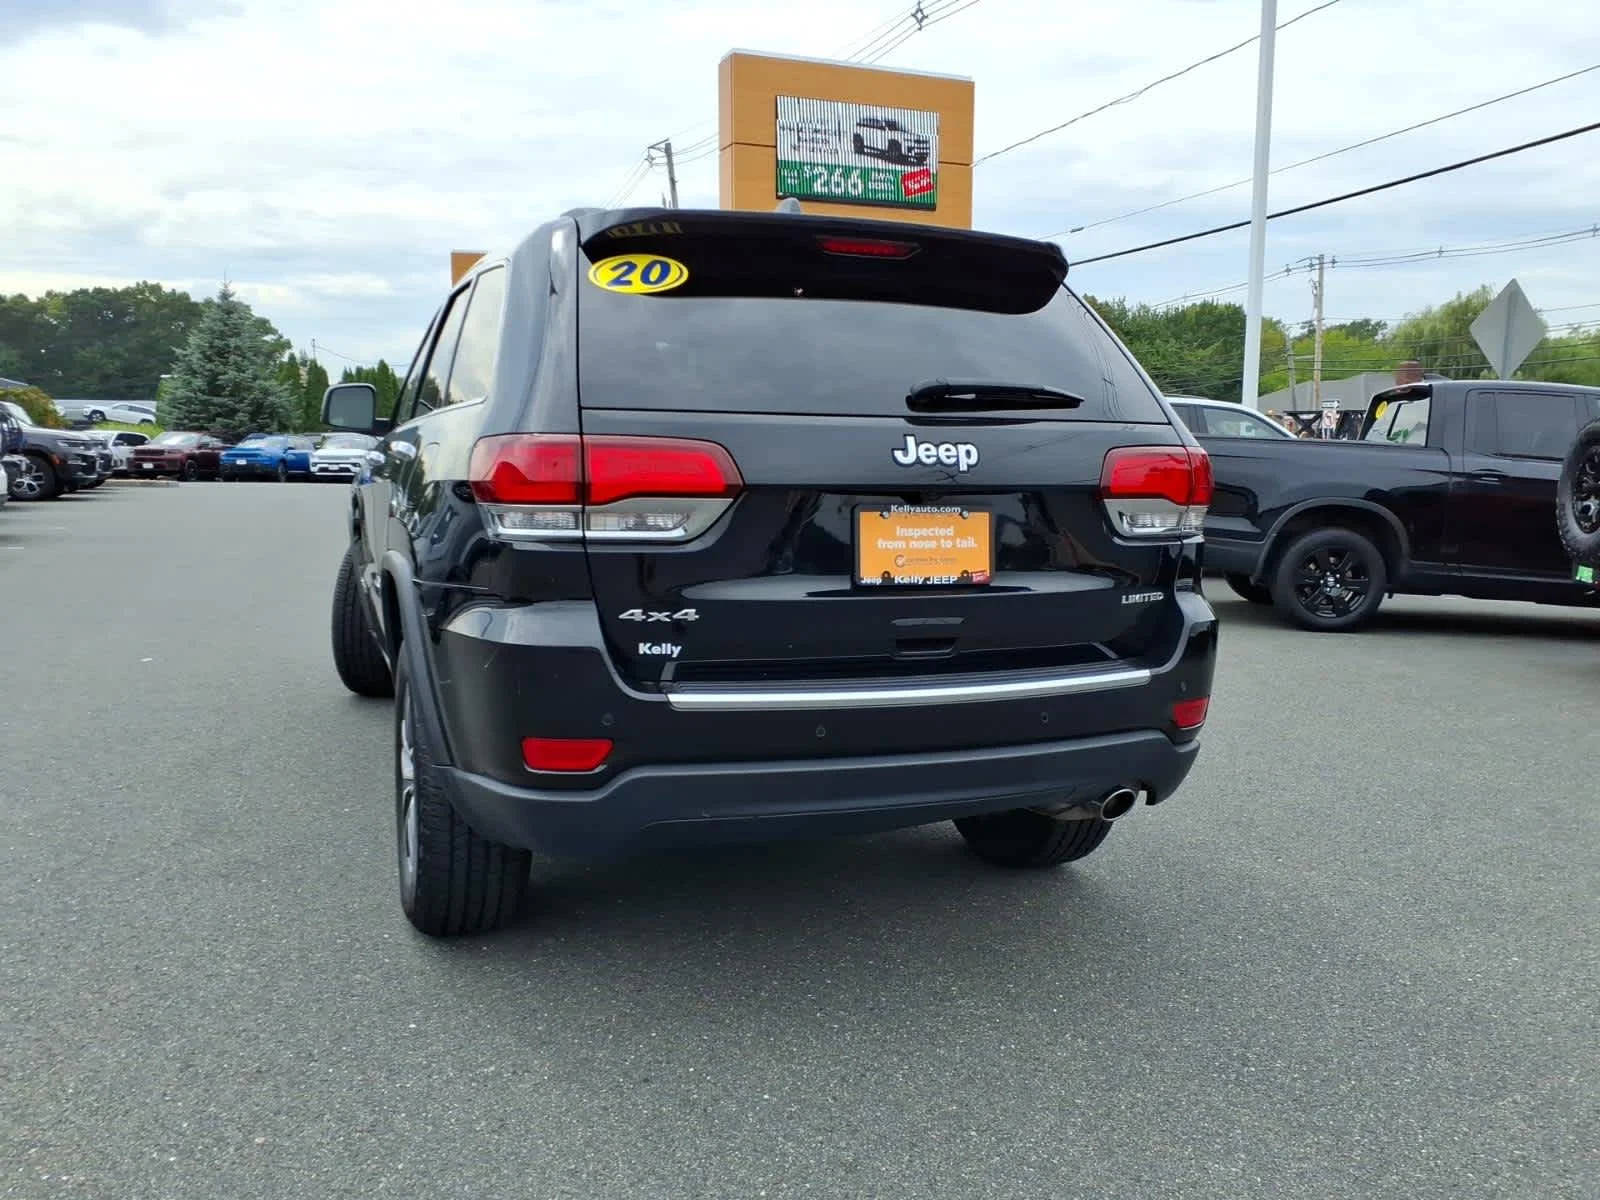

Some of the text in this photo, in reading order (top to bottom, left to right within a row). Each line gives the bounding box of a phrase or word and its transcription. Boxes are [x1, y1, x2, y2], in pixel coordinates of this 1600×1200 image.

[607, 259, 671, 287] 20
[892, 433, 980, 473] Jeep
[891, 504, 961, 514] Kellyauto.com
[896, 525, 954, 538] Inspected
[877, 536, 978, 550] from nose to tail.
[894, 575, 925, 585] Kelly
[926, 575, 958, 585] JEEP
[1121, 592, 1164, 604] LIMITED
[618, 608, 700, 622] 4x4
[638, 642, 682, 658] Kelly
